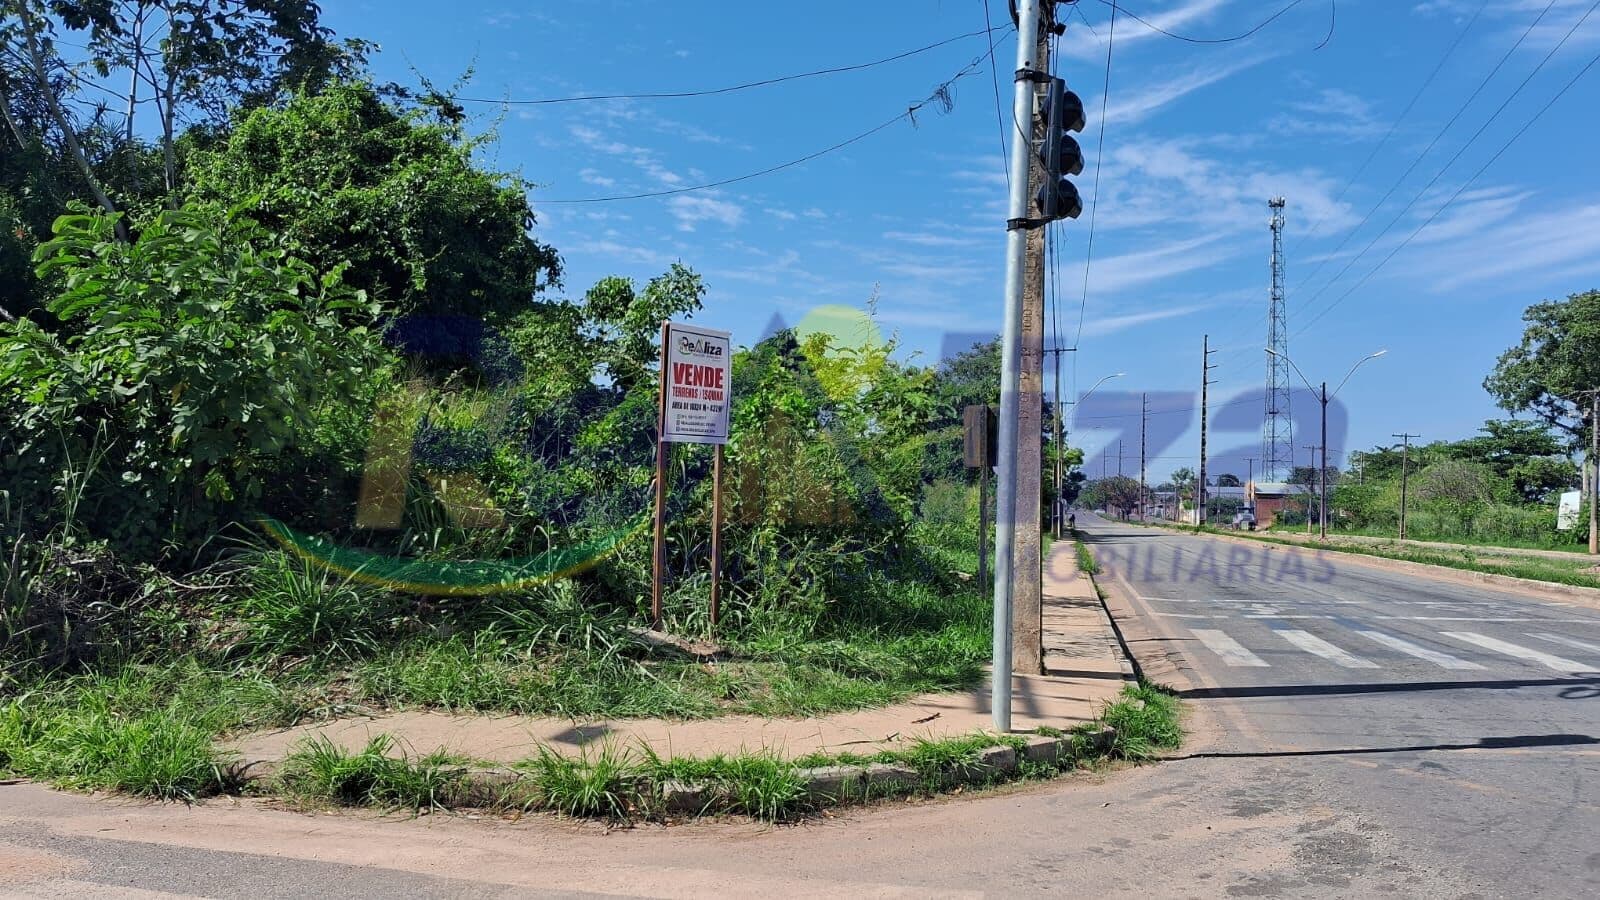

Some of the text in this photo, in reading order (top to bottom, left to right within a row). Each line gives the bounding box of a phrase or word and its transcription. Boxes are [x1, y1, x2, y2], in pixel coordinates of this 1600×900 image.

[673, 362, 724, 388] VENDE
[672, 386, 699, 398] TERRENOS
[703, 389, 723, 401] ESQUINA
